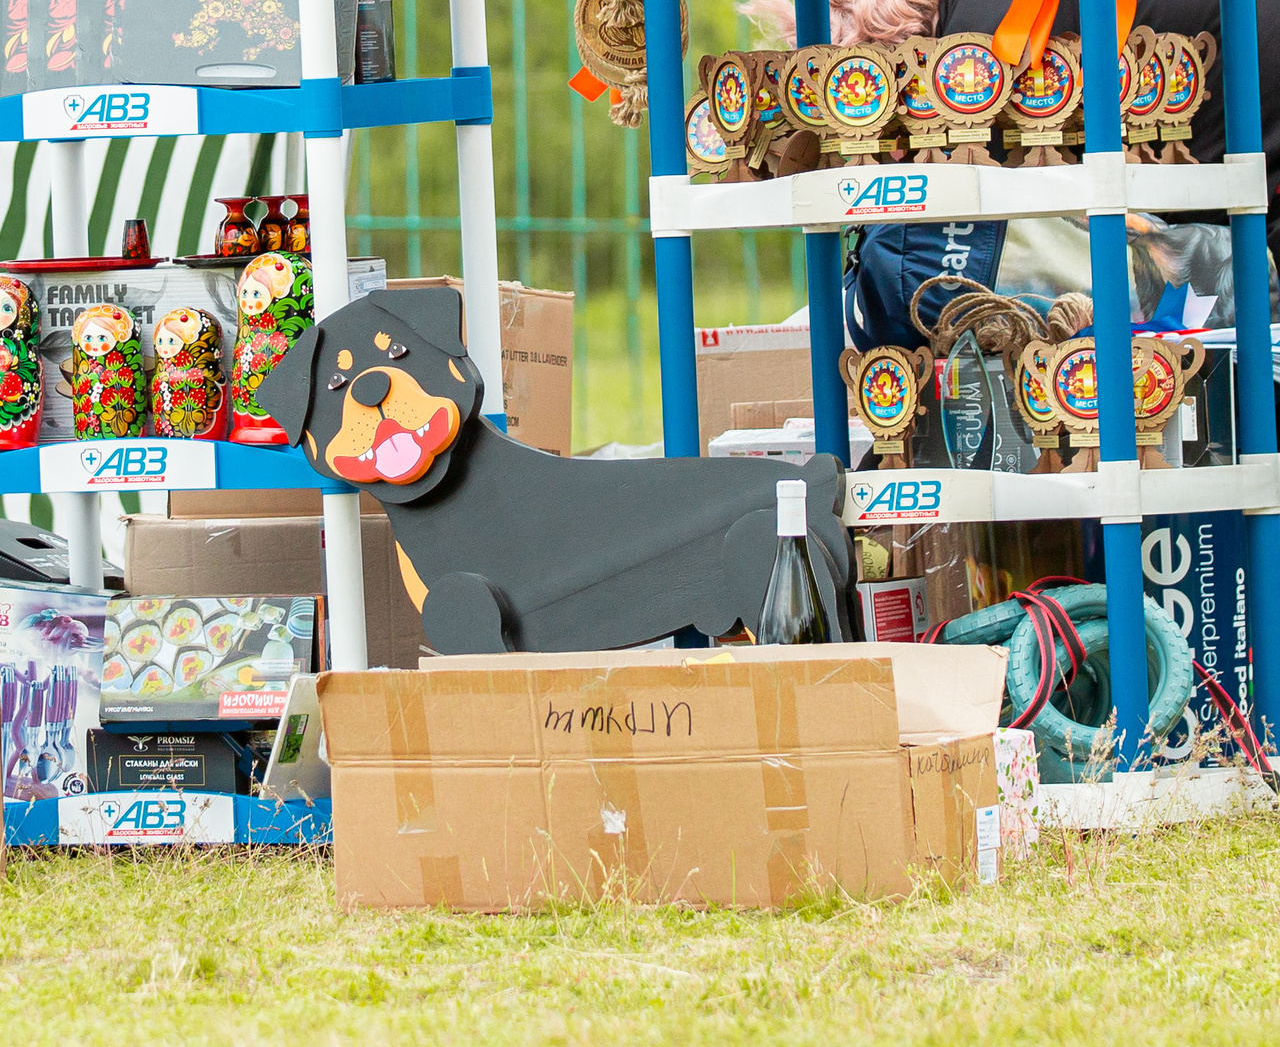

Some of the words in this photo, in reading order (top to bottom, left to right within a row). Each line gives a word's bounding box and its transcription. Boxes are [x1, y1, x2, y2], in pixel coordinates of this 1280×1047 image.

[602, 50, 644, 65] ЛУЧШАЯ
[957, 59, 975, 93] 1
[726, 77, 736, 112] 3
[848, 71, 867, 106] 3
[954, 92, 984, 104] МЕСТО
[1026, 96, 1054, 106] МЕСТО
[844, 106, 872, 116] МЕСТО
[47, 284, 128, 304] FAMILY
[510, 351, 529, 362] LITTER
[542, 354, 568, 367] LAVENDER
[877, 372, 893, 407] 3
[1076, 363, 1095, 398] 1
[1074, 398, 1097, 408] МЕСТ
[1233, 567, 1246, 659] italiano
[157, 736, 195, 744] PROMSIZ
